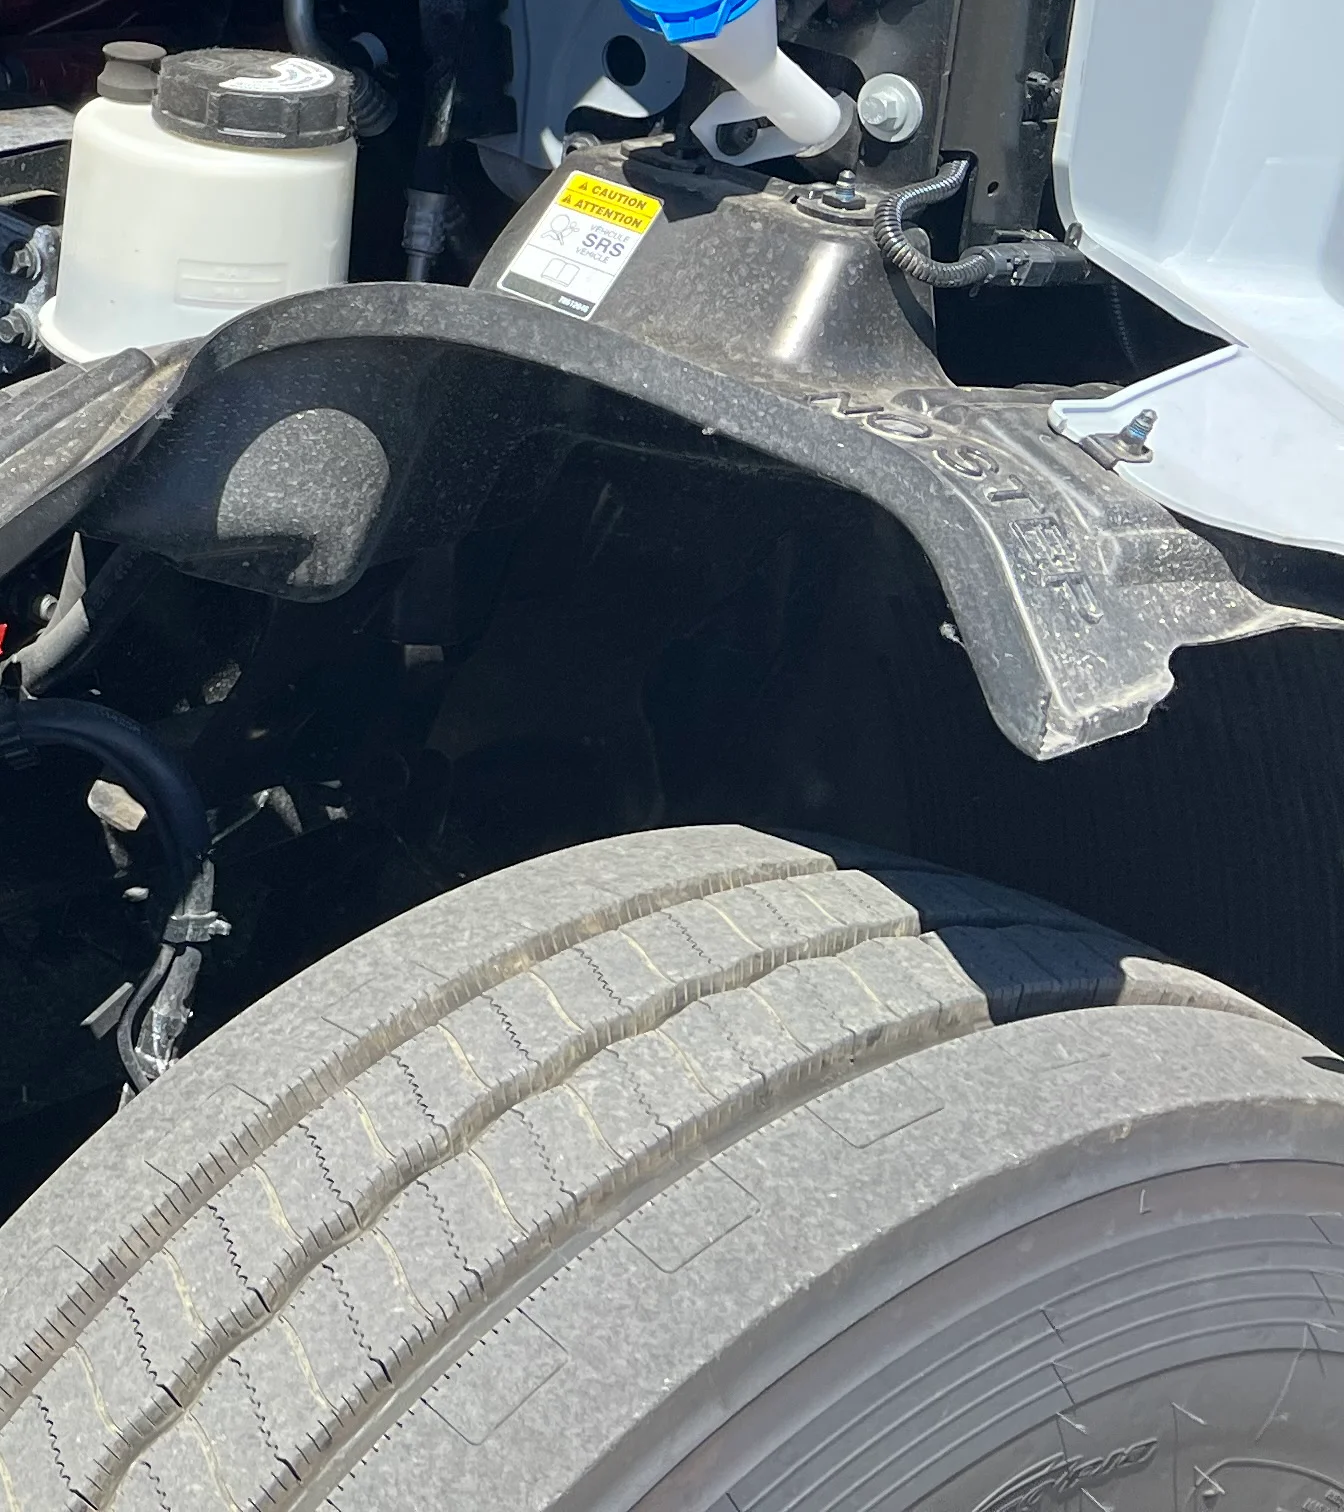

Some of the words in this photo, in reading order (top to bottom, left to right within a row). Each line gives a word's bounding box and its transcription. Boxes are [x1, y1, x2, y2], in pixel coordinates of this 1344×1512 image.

[592, 185, 647, 211] CAUTION
[574, 199, 643, 229] ATTENTION
[582, 233, 625, 257] SRS
[805, 391, 934, 441] NO
[931, 444, 1105, 625] STEP
